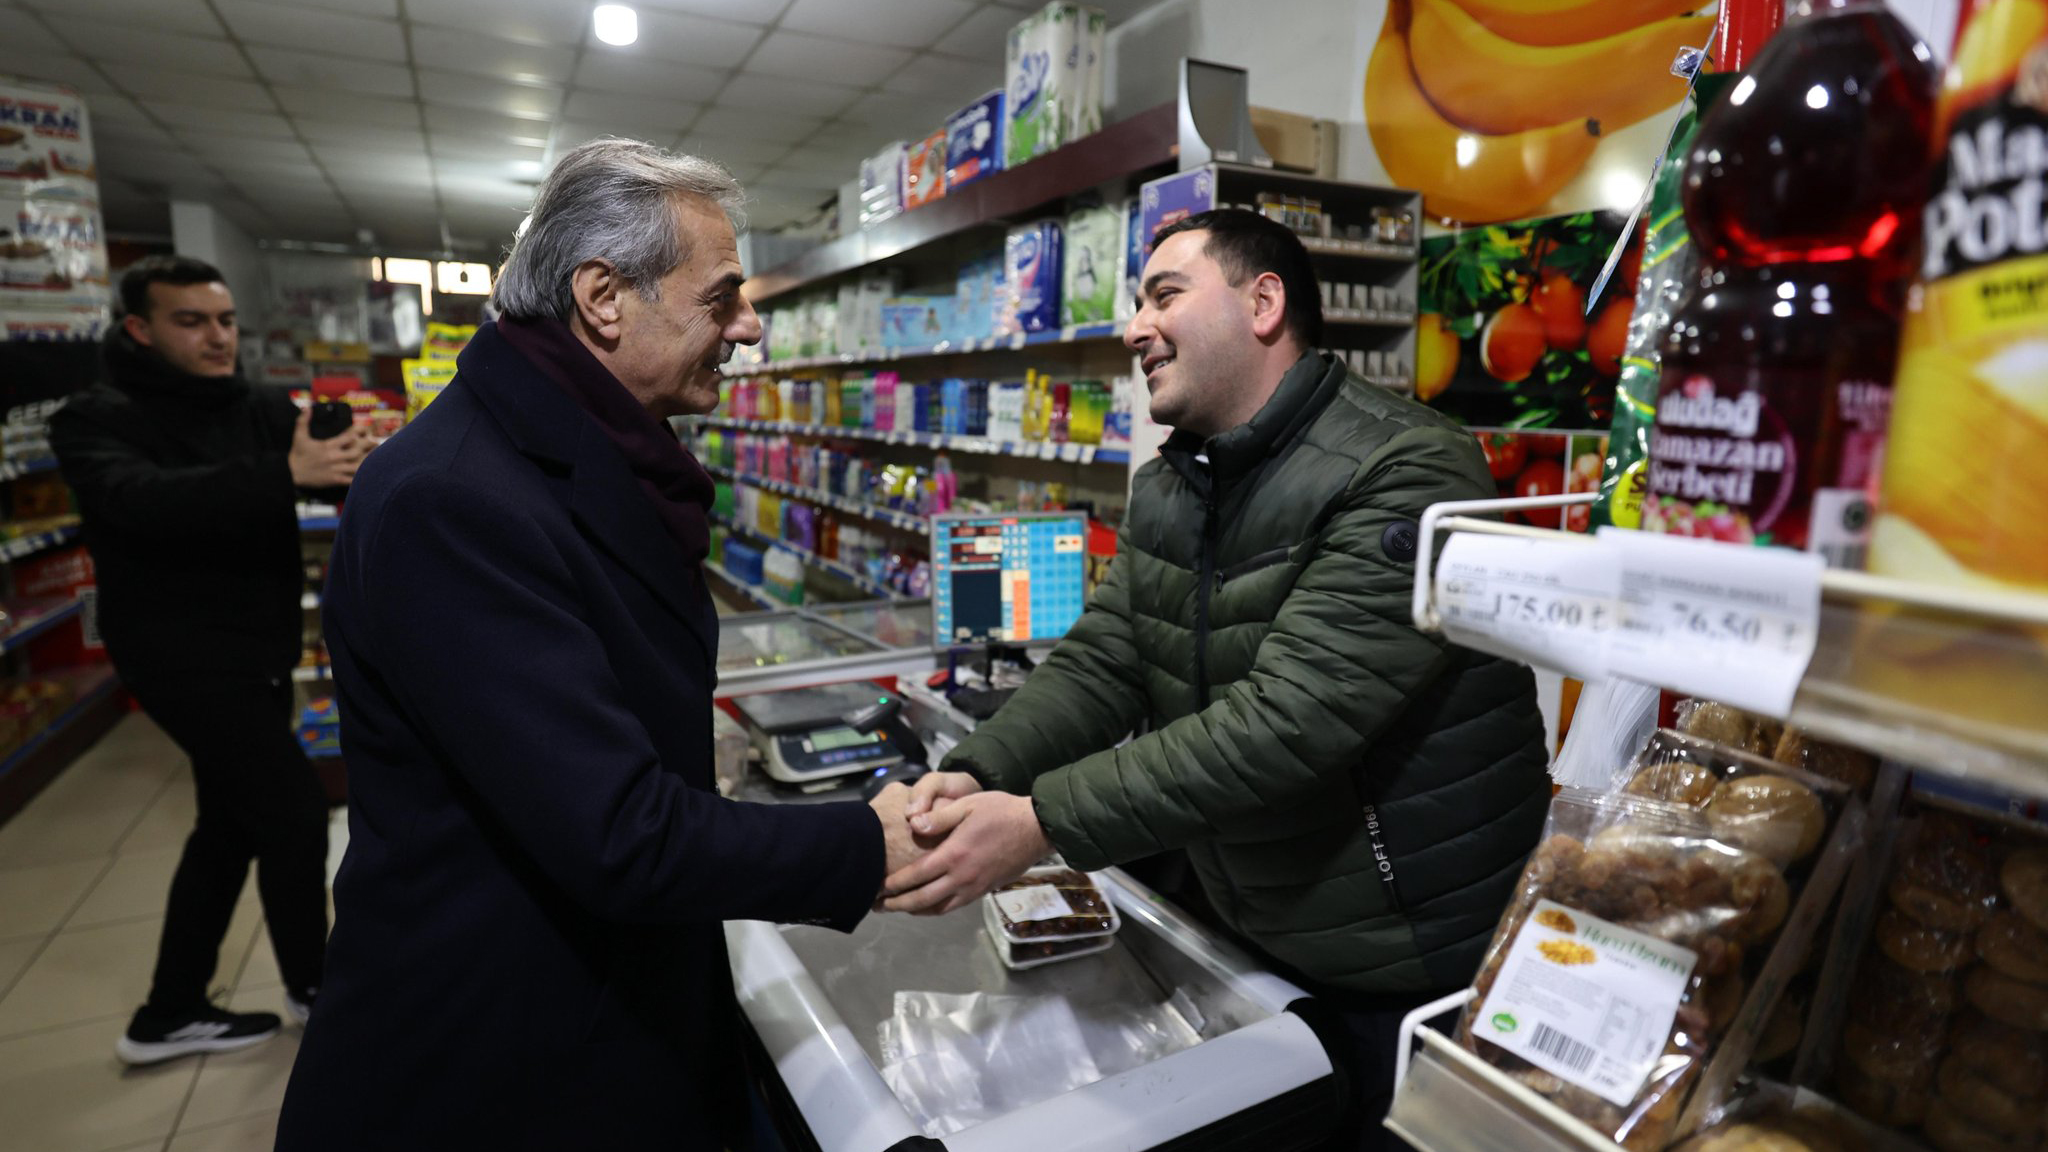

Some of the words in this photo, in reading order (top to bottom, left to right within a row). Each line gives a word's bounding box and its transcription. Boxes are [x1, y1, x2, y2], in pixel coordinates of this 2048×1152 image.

[1922, 178, 2048, 280] Pot
[1362, 803, 1381, 837] 1968
[1371, 842, 1394, 882] LOFT
